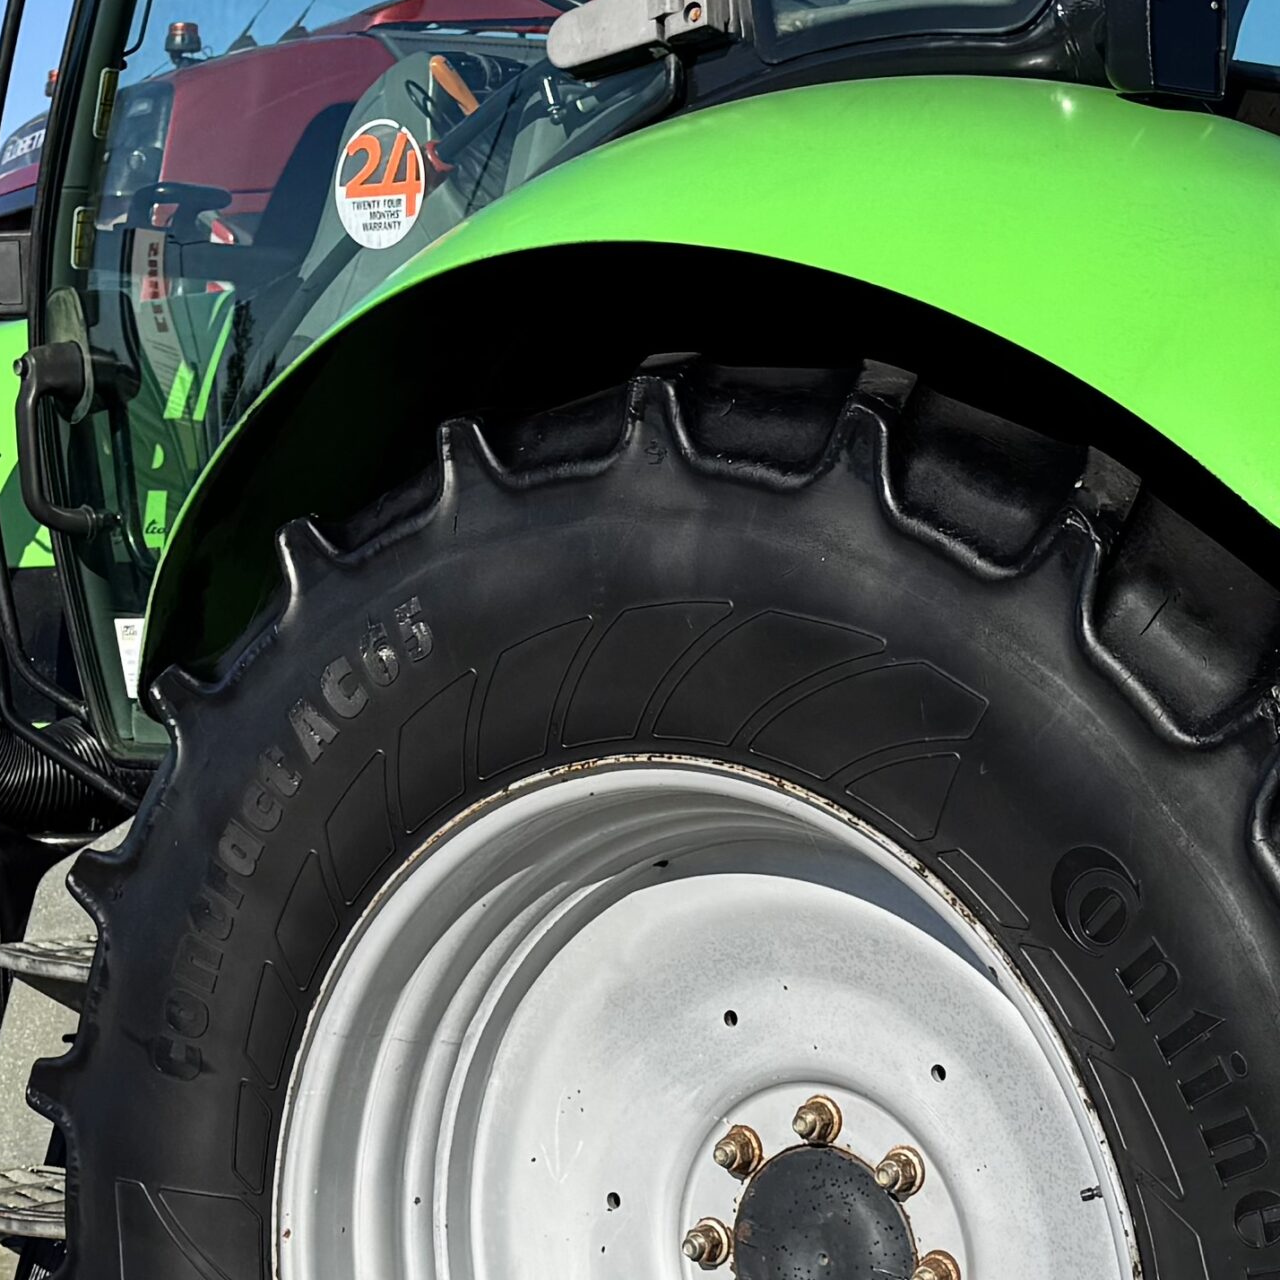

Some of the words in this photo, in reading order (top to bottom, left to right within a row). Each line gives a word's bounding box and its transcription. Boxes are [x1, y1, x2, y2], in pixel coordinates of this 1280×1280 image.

[344, 132, 422, 218] 24
[352, 199, 381, 211] TWENTY
[383, 197, 402, 209] FOUR
[362, 220, 402, 232] WARRANTY
[287, 595, 434, 765] AC65
